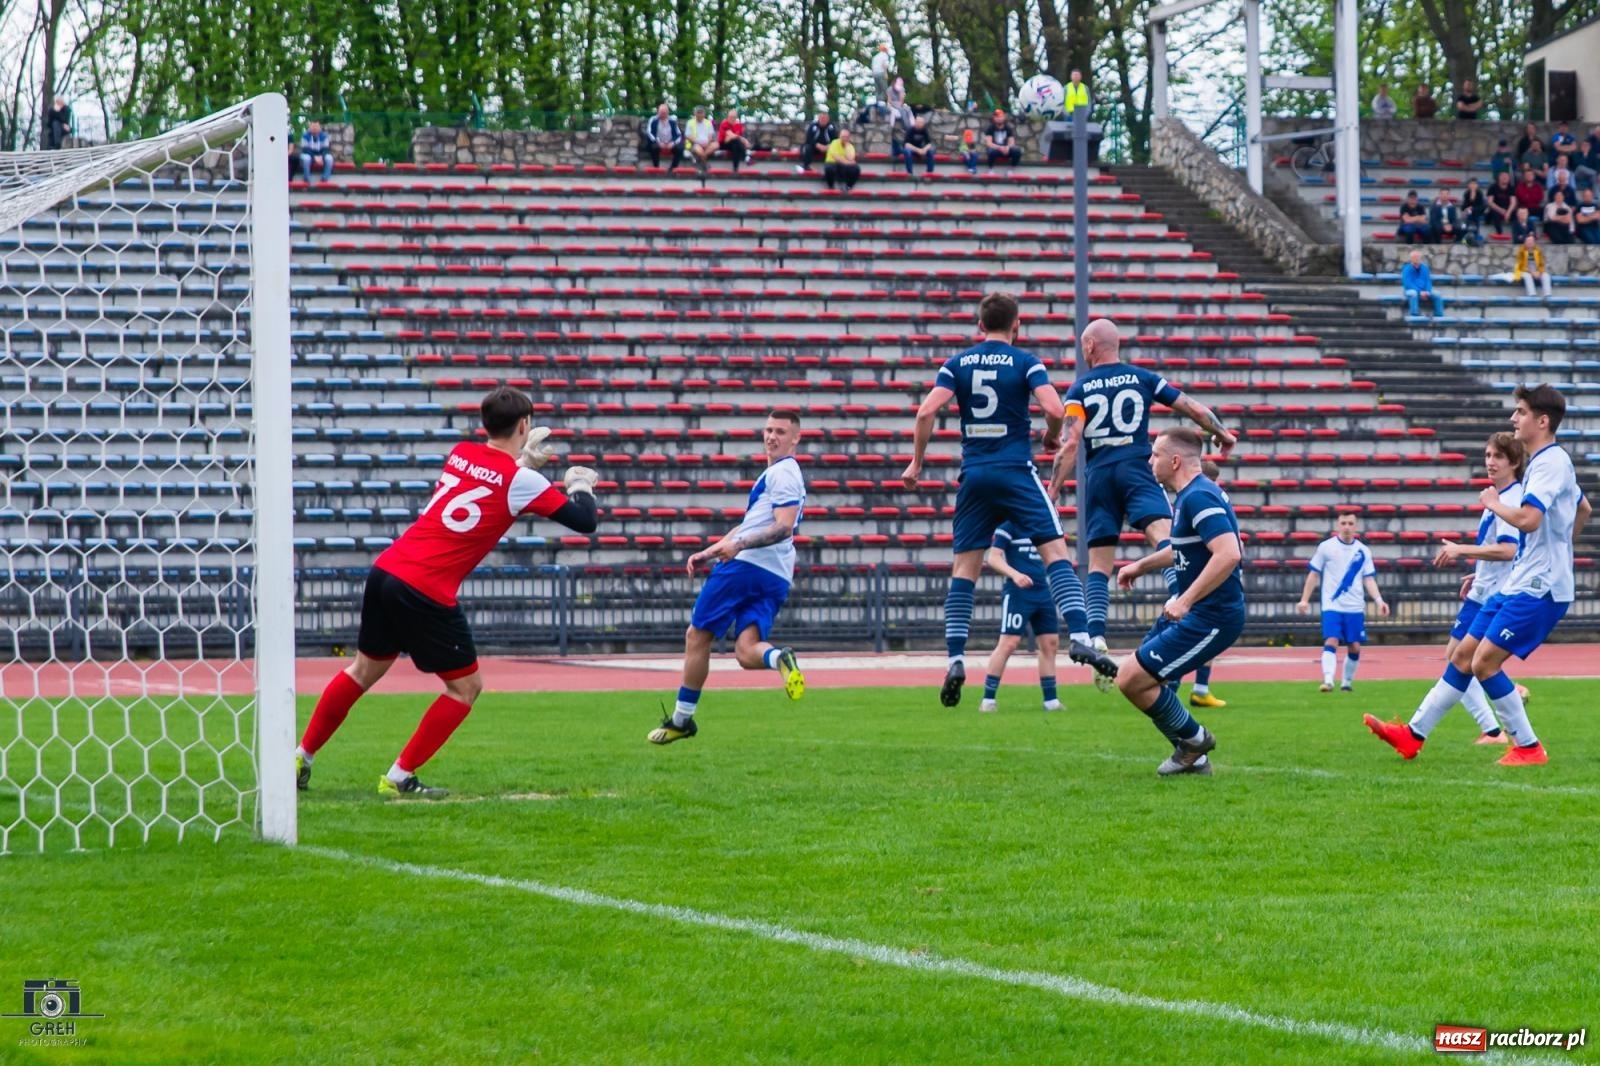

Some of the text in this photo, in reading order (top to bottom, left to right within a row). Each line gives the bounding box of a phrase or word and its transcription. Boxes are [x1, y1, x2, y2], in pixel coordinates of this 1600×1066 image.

[960, 354, 979, 367] 1908
[971, 369, 998, 419] 5
[1083, 374, 1140, 393] 1908 NĘDZA
[1083, 388, 1145, 438] 20
[448, 453, 504, 487] 1908 NĘDZA
[422, 471, 494, 533] 76
[1006, 612, 1023, 630] 10
